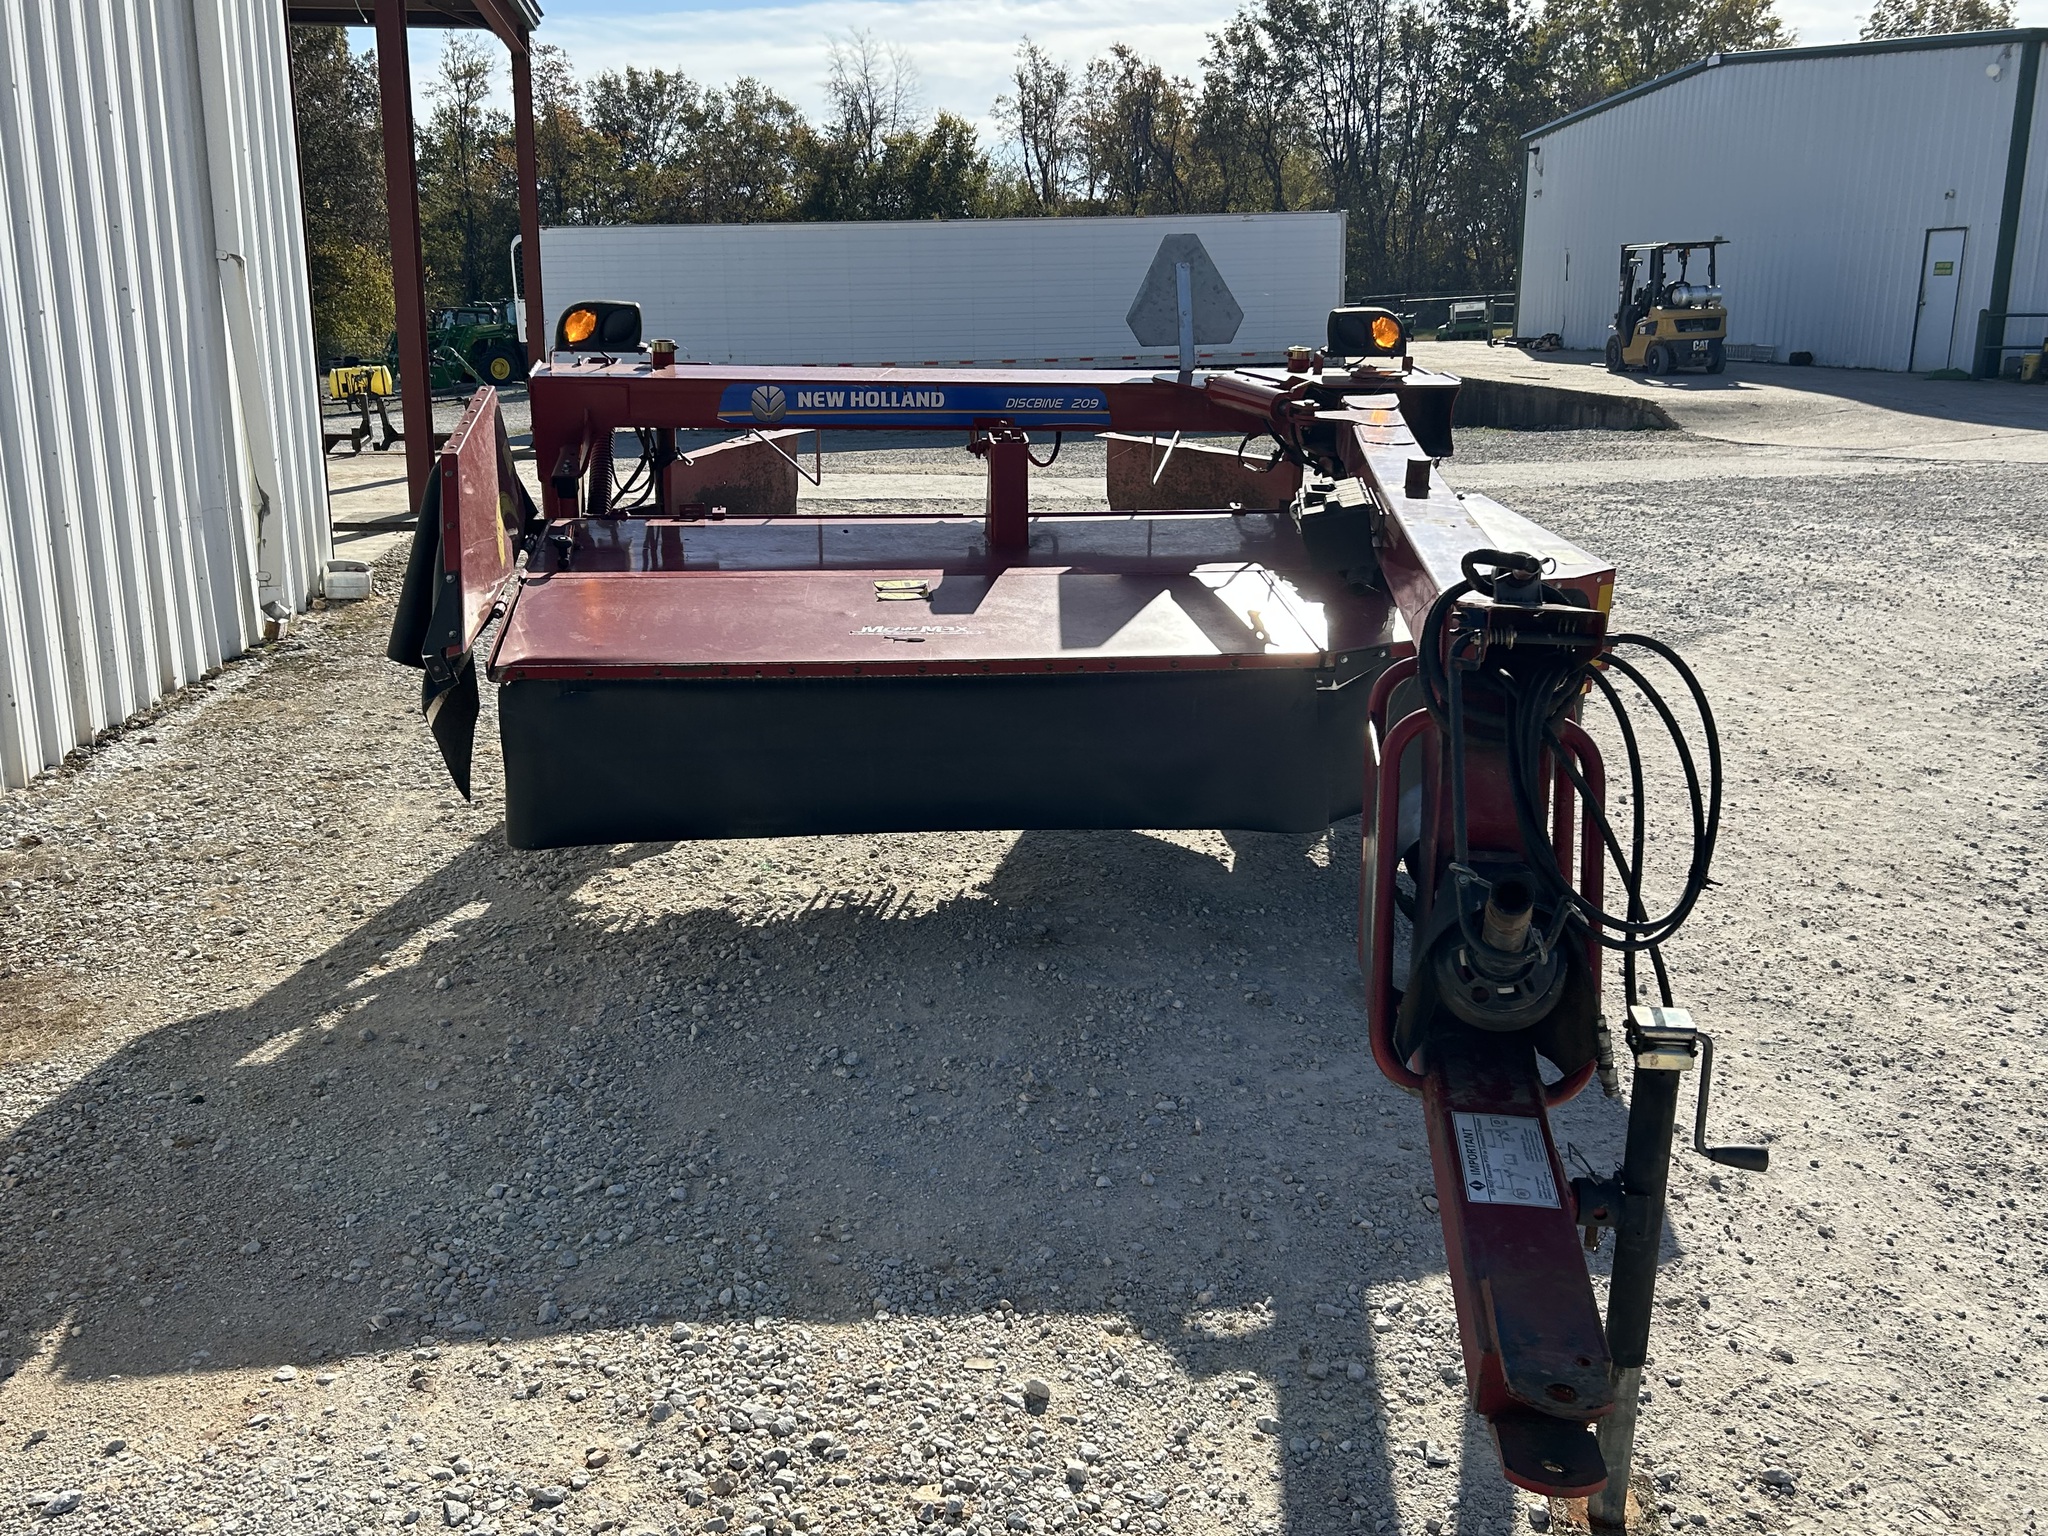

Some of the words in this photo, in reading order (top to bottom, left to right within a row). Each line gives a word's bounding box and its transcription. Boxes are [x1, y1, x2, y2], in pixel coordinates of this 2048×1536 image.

[1693, 340, 1709, 350] CAT
[797, 391, 844, 407] NEW
[851, 391, 944, 408] HOLLAND
[1005, 399, 1063, 408] DISCBINE
[1072, 399, 1098, 408] 209
[1461, 1127, 1480, 1175] IMPORTANT
